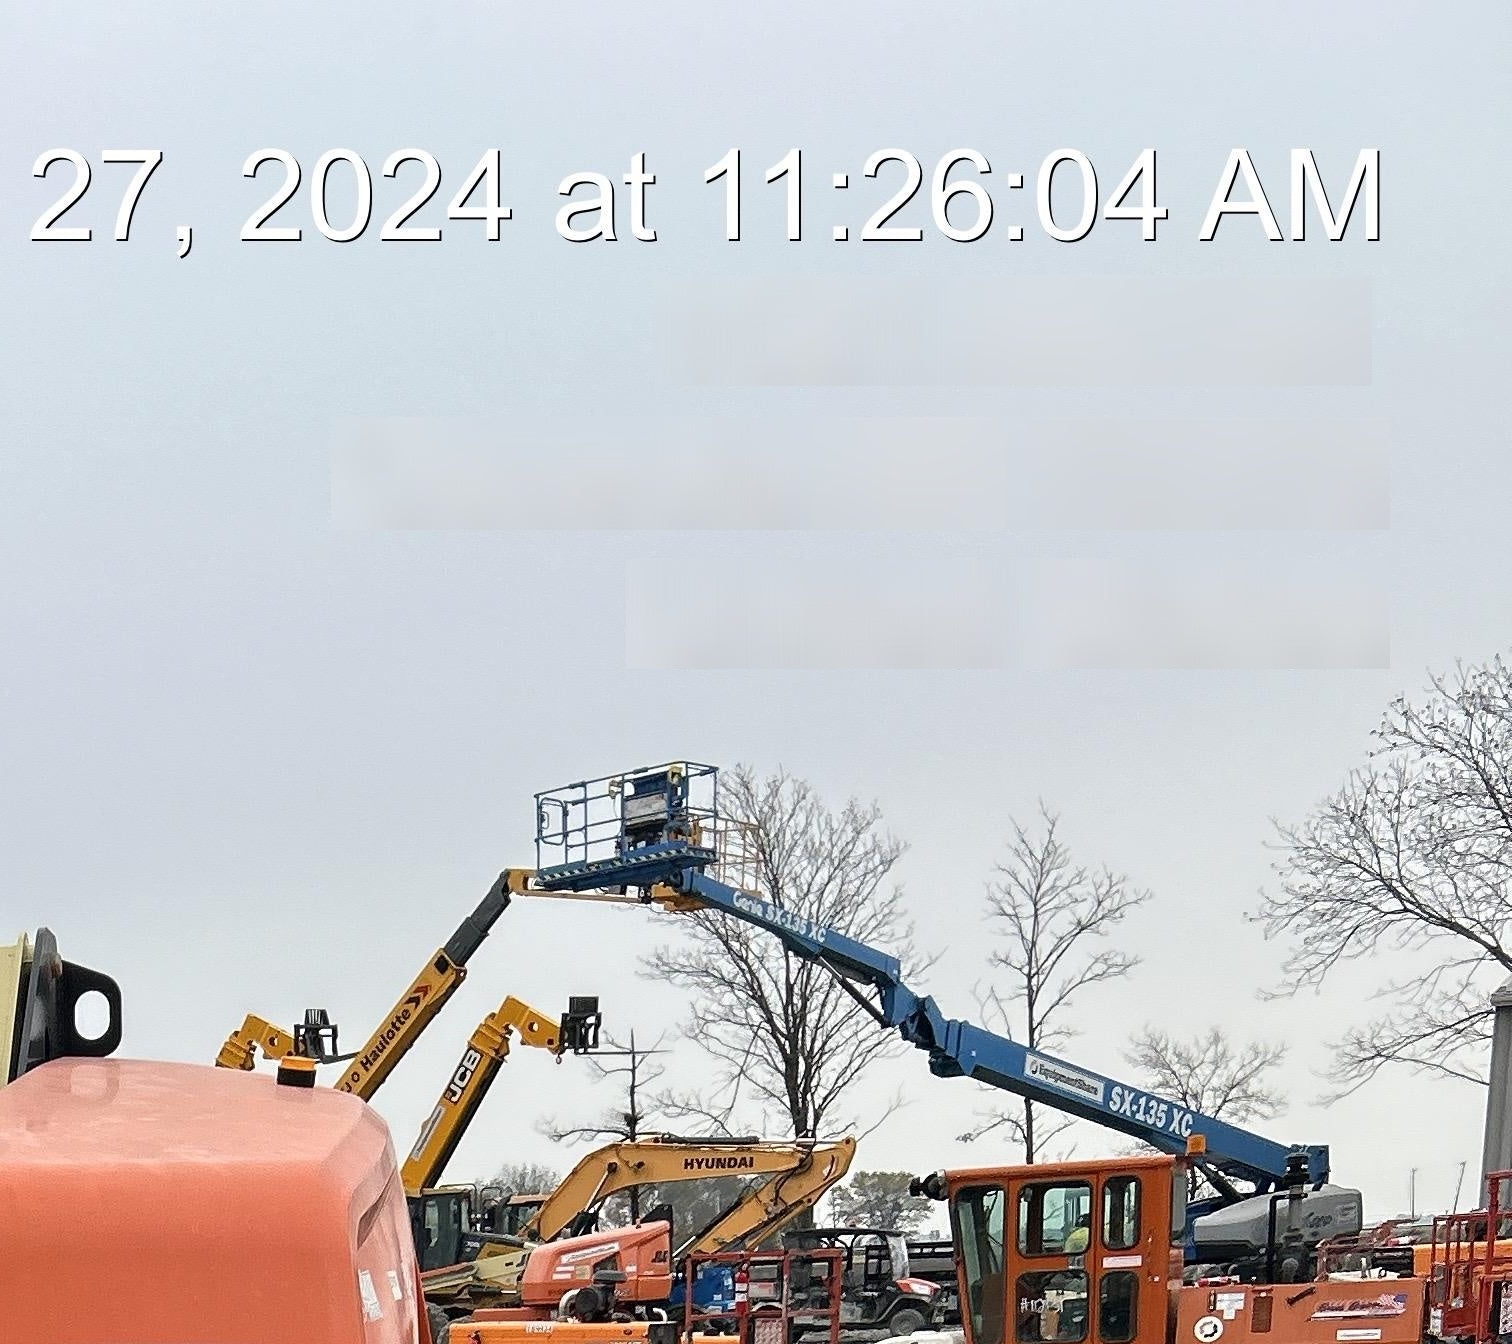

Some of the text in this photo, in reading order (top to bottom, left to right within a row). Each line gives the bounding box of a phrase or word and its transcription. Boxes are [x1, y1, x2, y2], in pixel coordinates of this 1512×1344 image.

[360, 1008, 411, 1072] Haulotte
[447, 1050, 482, 1103] JCB
[1109, 1085, 1193, 1137] SX-135 XC
[683, 1156, 755, 1170] HYUNDAI
